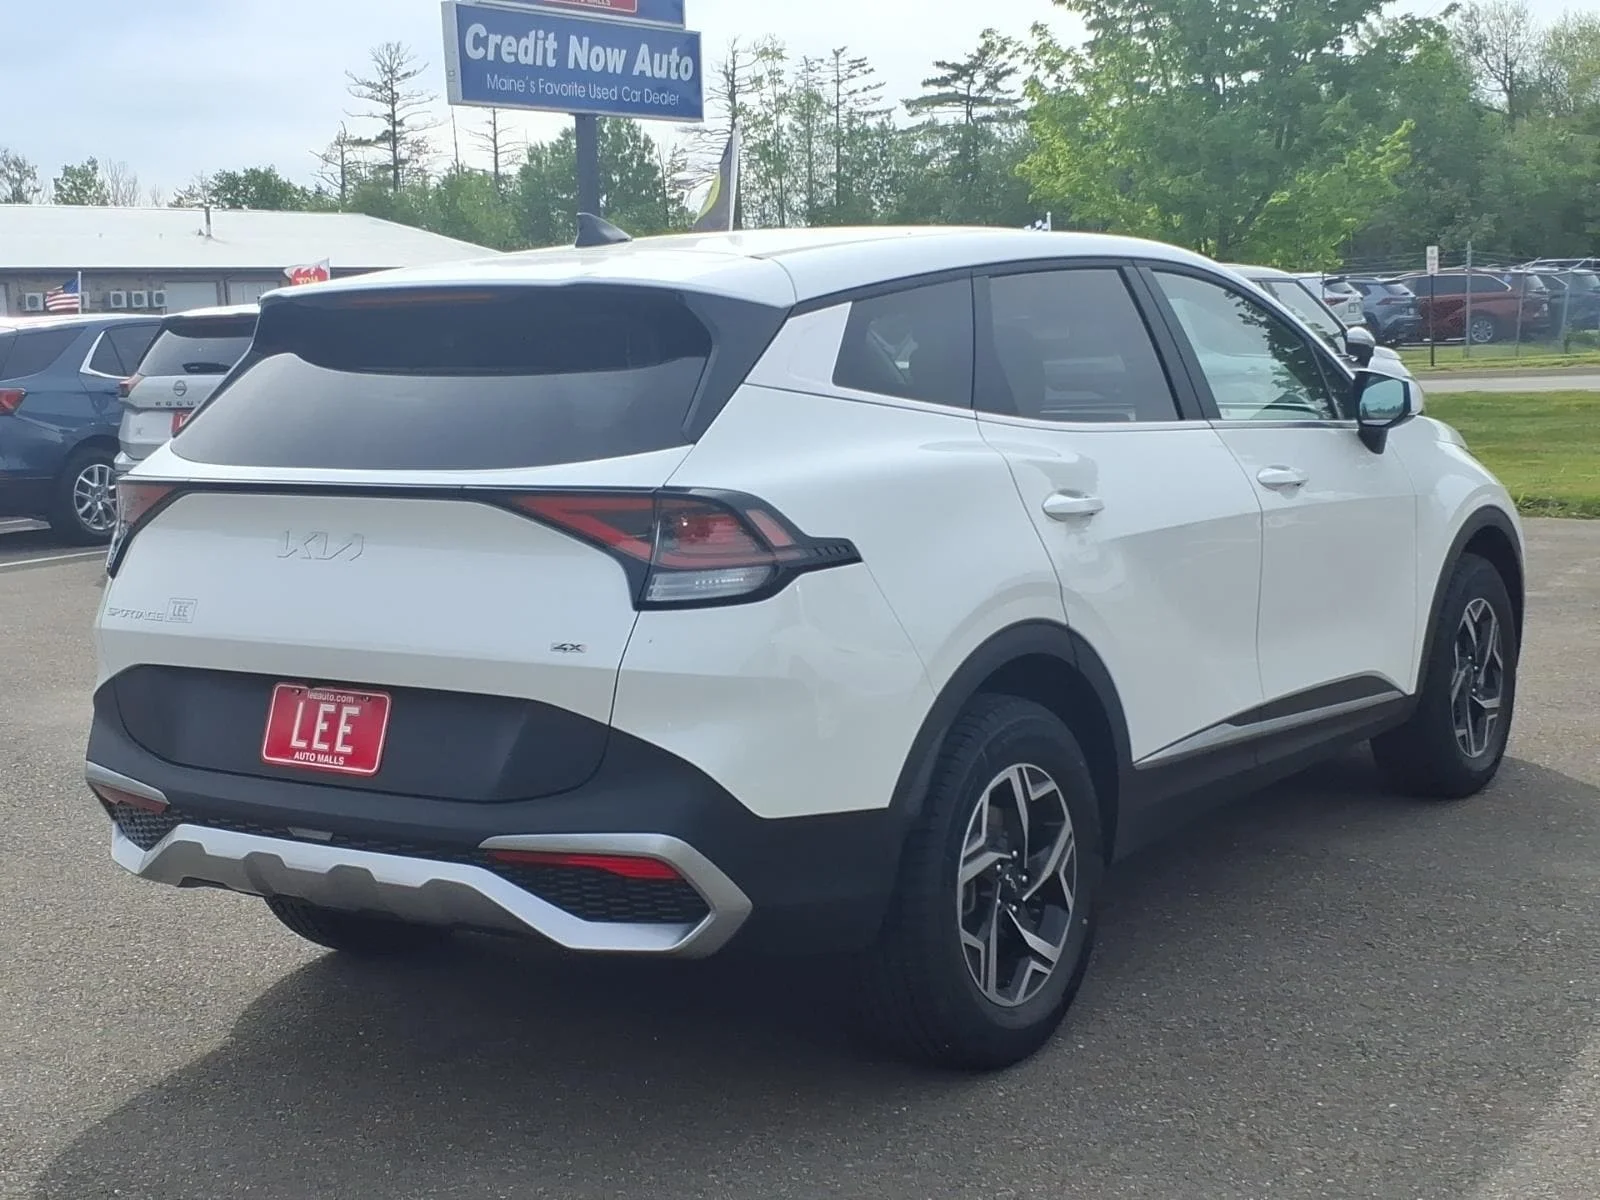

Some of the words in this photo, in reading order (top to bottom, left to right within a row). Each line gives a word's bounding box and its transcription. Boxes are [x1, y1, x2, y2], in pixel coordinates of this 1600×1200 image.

[465, 23, 557, 68] Credit
[568, 35, 627, 74] Now
[633, 43, 693, 81] Auto
[487, 74, 536, 94] Maine's
[539, 78, 586, 99] Favorite
[589, 83, 617, 101] Used
[622, 86, 641, 103] Car
[645, 88, 679, 106] Dealer
[308, 690, 354, 703] leeauto.com
[290, 702, 360, 753] LEE
[294, 752, 316, 762] AUTO
[317, 754, 345, 766] MALLS
